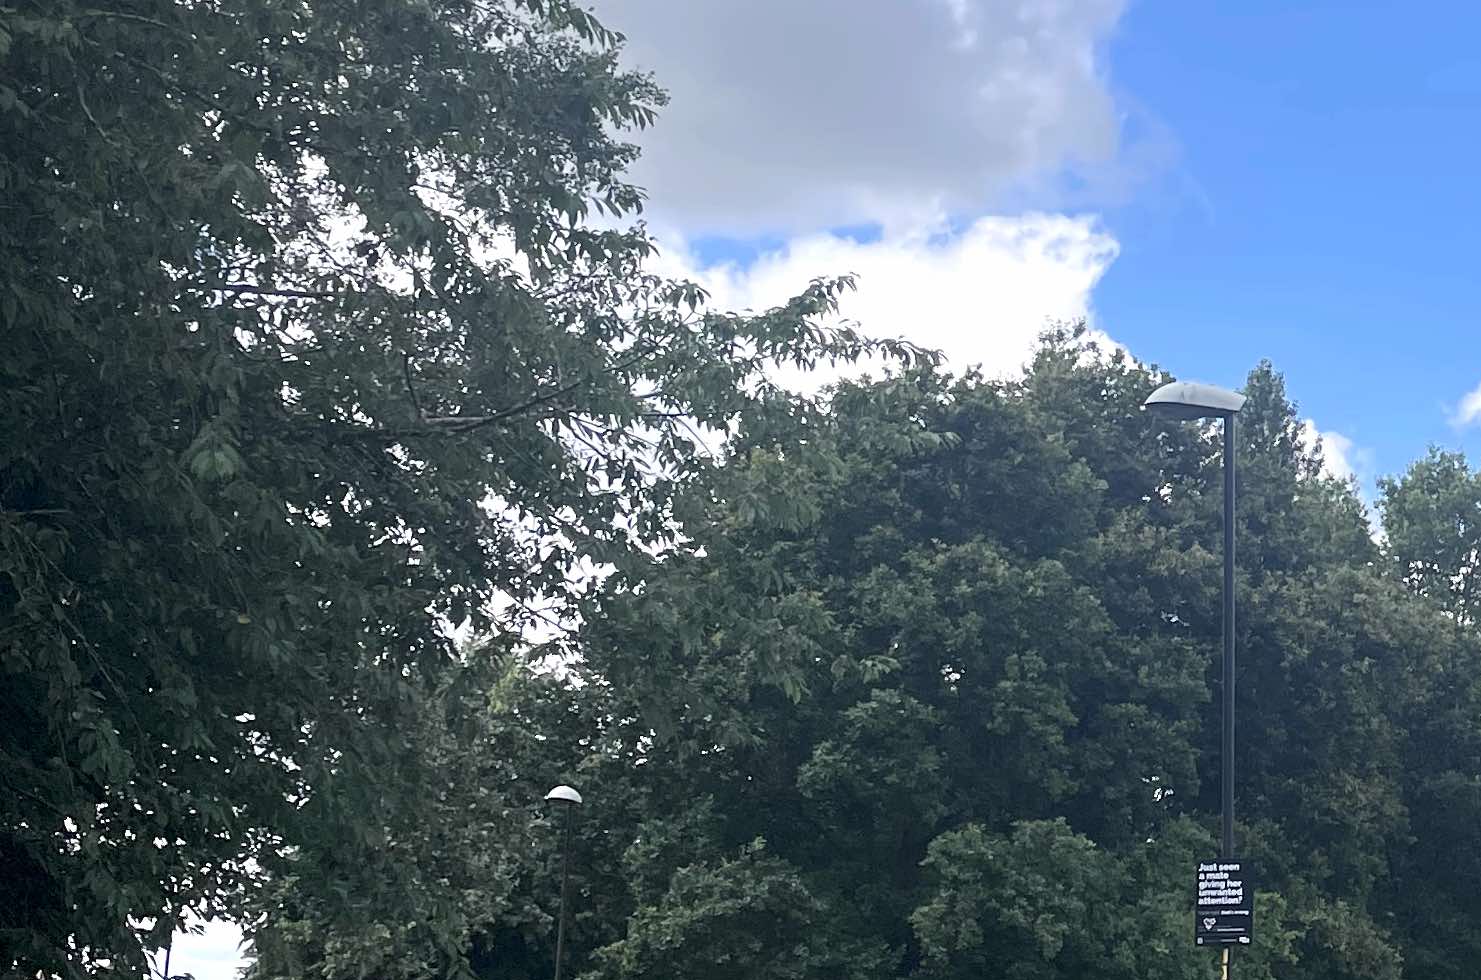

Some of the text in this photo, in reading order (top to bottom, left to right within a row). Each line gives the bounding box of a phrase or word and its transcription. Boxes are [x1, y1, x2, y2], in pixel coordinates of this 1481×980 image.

[1199, 863, 1217, 872] Just
[1199, 880, 1225, 889] giving
[1199, 888, 1243, 896] unwanted
